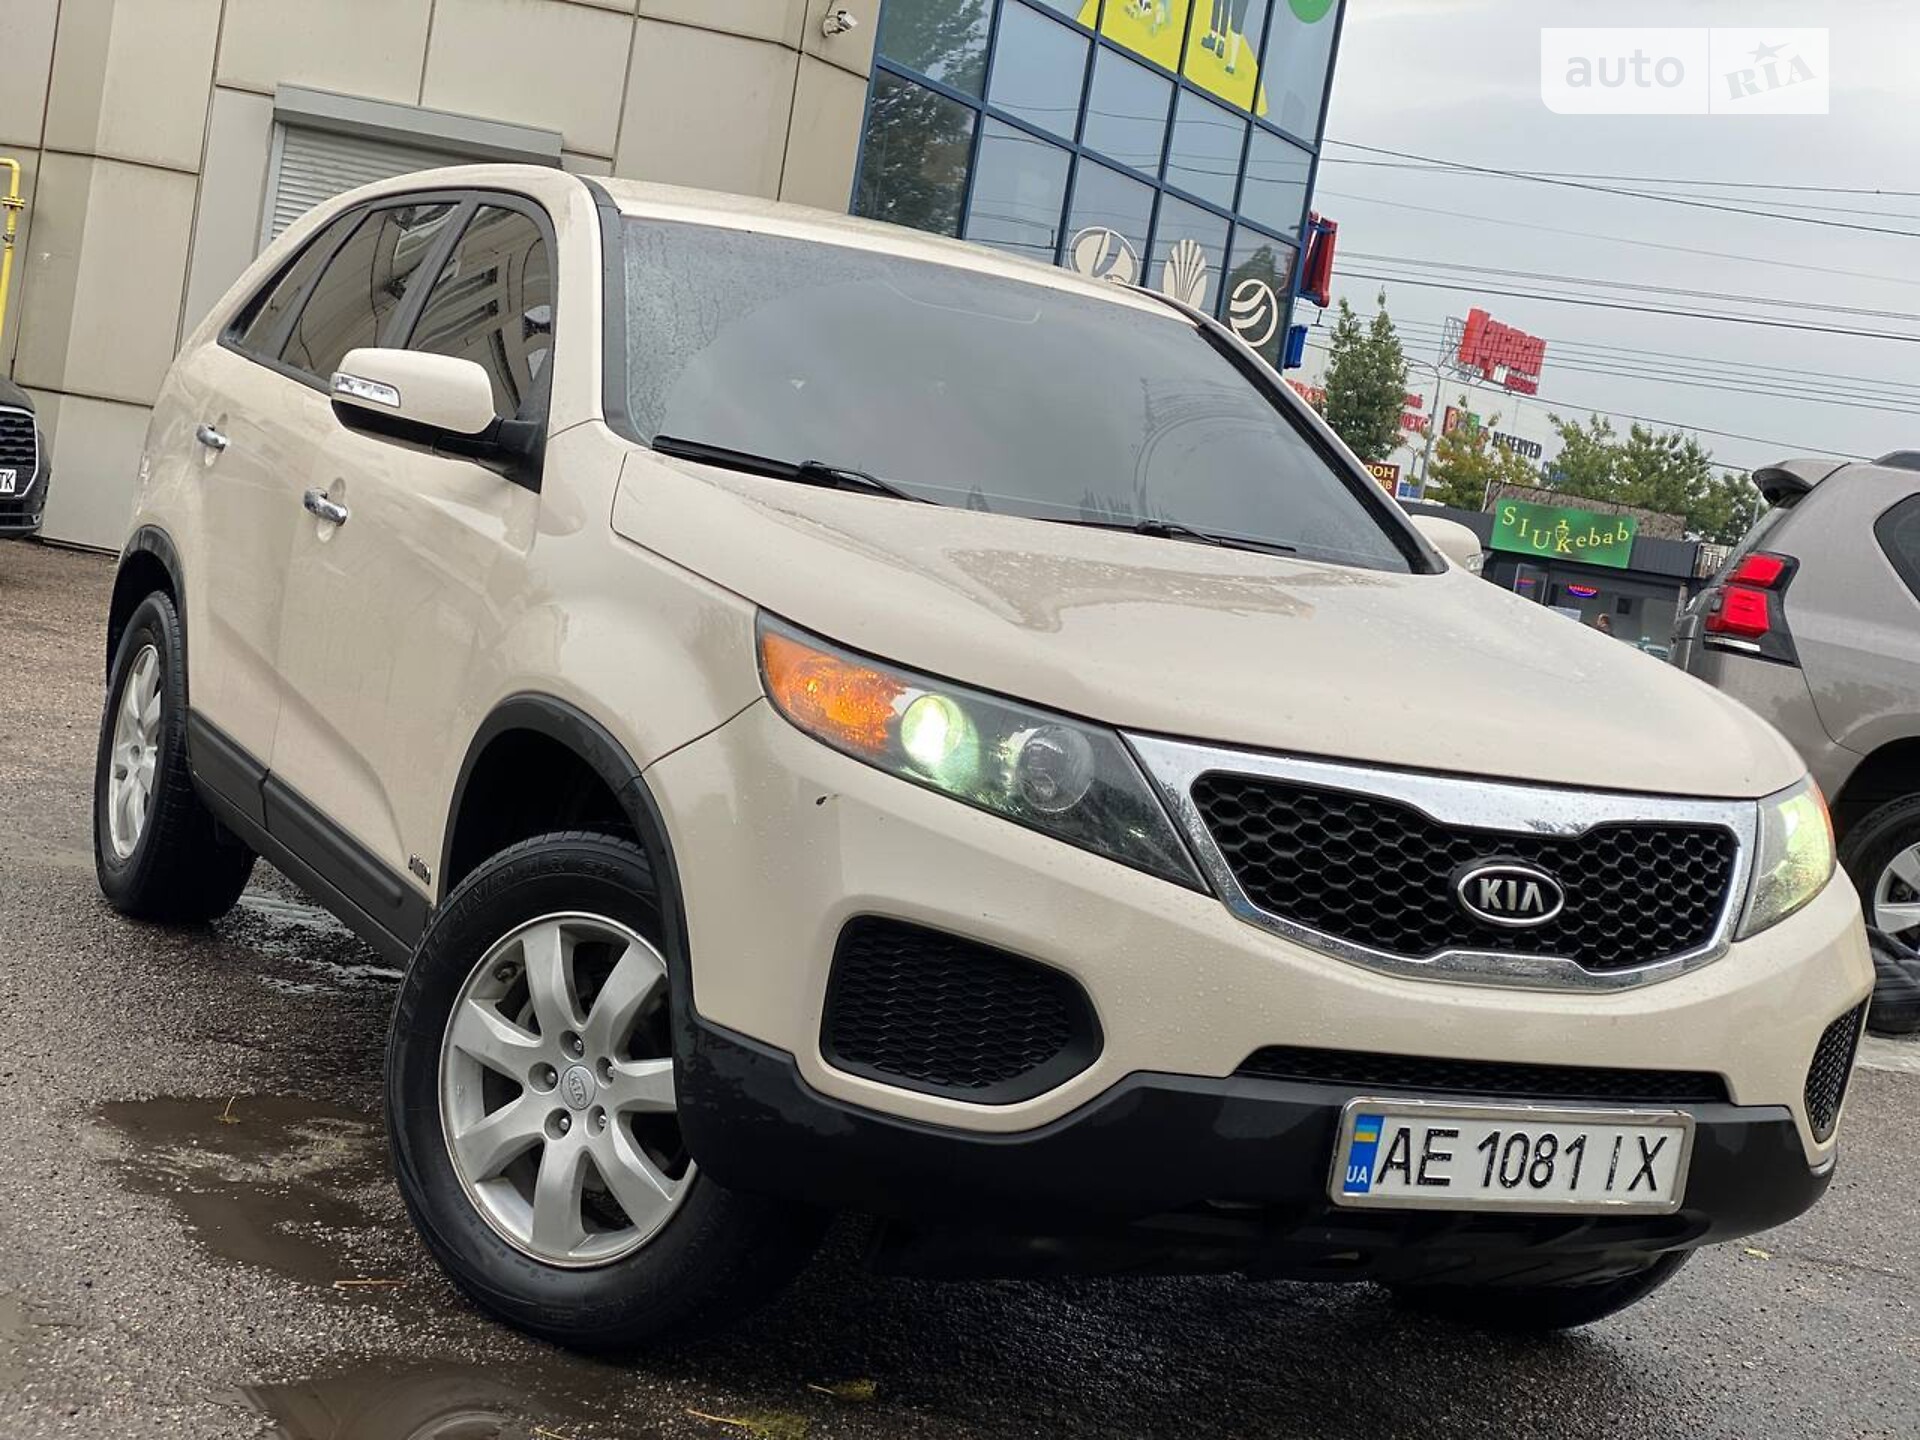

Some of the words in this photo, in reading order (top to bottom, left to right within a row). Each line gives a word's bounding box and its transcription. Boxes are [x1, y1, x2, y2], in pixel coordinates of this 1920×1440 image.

[1480, 878, 1544, 912] KIA
[1346, 1165, 1368, 1184] UA
[1376, 1127, 1459, 1187] AE
[1477, 1129, 1588, 1191] 1081
[1604, 1135, 1668, 1192] IX
